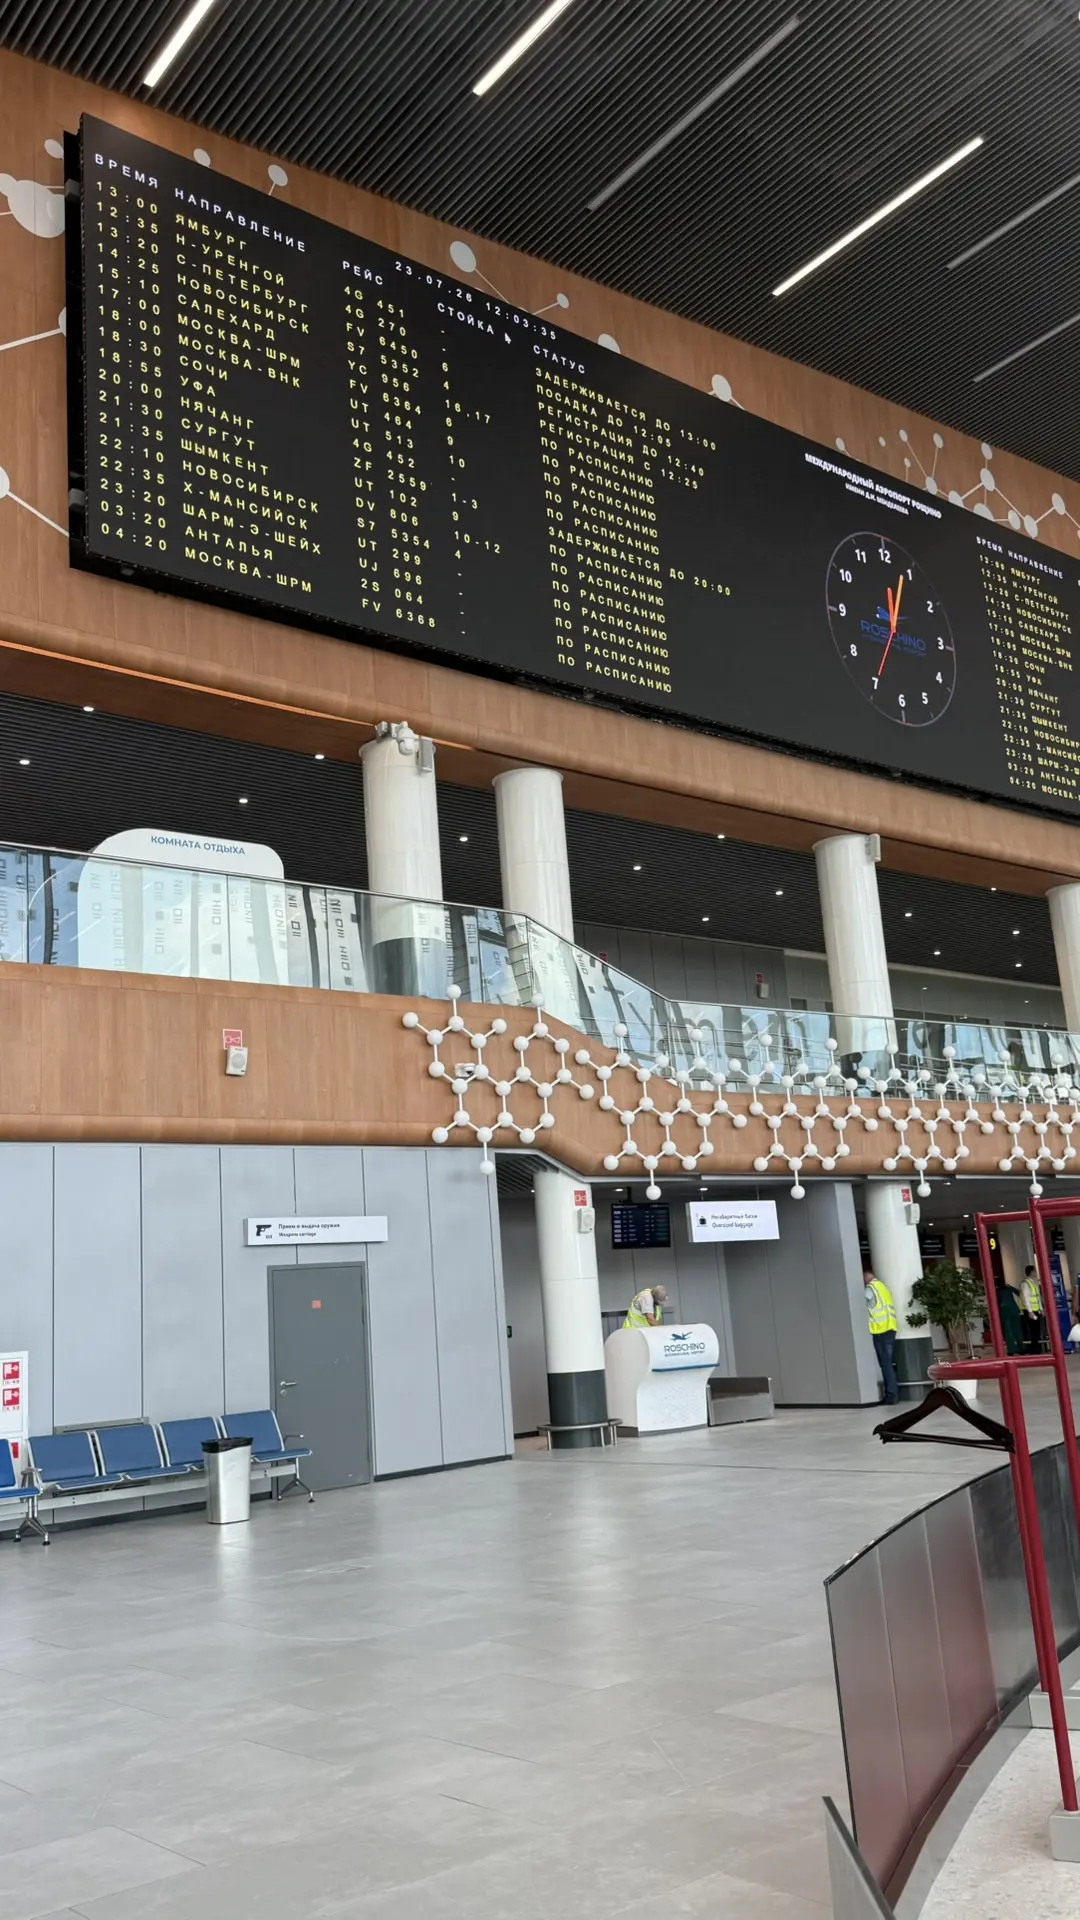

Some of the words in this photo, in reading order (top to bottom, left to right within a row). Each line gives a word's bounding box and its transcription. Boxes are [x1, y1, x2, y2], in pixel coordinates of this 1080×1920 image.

[95, 153, 158, 189] ВРЕМЯ
[175, 188, 305, 252] НАПРАВЛЕНИЕ
[342, 261, 383, 285] РЕЙС
[437, 302, 494, 335] СТОЙКА
[533, 345, 585, 374] СТАТУС
[97, 181, 157, 214] 13:00
[176, 214, 246, 250] ЯМБУРГ
[344, 286, 363, 300] 4G
[377, 300, 404, 318] 451
[536, 367, 646, 421] ЗАДЕРЖИВАЕТСЯ
[656, 418, 670, 431] ДО
[680, 429, 716, 450] 13:00
[395, 261, 472, 302] 23.07.26
[486, 302, 556, 340] 12:03:35
[97, 201, 158, 234] 12:35
[176, 233, 284, 286] Н-УРЕНГОЙ
[345, 305, 364, 318] 4G
[378, 317, 406, 336] 270
[536, 384, 597, 417] ПОСАДКА
[607, 414, 623, 427] ДО
[634, 425, 671, 447] 12:05
[97, 222, 158, 254] 13:20
[177, 254, 308, 313] С-ПЕТЕРБУРГ
[346, 322, 364, 337] FV
[379, 336, 417, 359] 6450
[442, 362, 448, 372] 6
[538, 402, 632, 447] РЕГИСТРАЦИЯ
[642, 445, 657, 457] ДО
[668, 455, 704, 476] 12:40
[98, 243, 159, 274] 14:25
[177, 273, 309, 334] НОВОСИБИРСК
[347, 341, 365, 355] S7
[381, 355, 419, 378] 5352
[443, 381, 449, 390] 4
[540, 419, 634, 464] РЕГИСТРАЦИЯ
[644, 461, 650, 470] С
[661, 469, 698, 489] 12:25
[98, 263, 159, 294] 15:10
[178, 294, 275, 341] САЛЕХАРД
[348, 360, 367, 375] YC
[381, 373, 410, 392] 956
[541, 437, 557, 450] ПО
[568, 447, 653, 488] РАСПИСАНИЮ
[98, 284, 160, 315] 17:00
[178, 313, 300, 368] МОСКВА-ШРМ
[349, 379, 368, 394] FV
[383, 392, 421, 415] 6364
[446, 417, 452, 427] 6
[542, 454, 559, 468] ПО
[570, 465, 655, 504] РАСПИСАНИЮ
[99, 305, 160, 336] 18:00
[178, 334, 300, 388] МОСКВА-ВНК
[350, 398, 369, 413] UT
[384, 412, 412, 429] 464
[447, 436, 454, 445] 9
[544, 472, 560, 486] ПО
[571, 482, 656, 521] РАСПИСАНИЮ
[99, 326, 161, 356] 18:30
[180, 355, 227, 381] СОЧИ
[351, 418, 370, 432] UT
[385, 430, 413, 449] 513
[449, 455, 465, 468] 10
[545, 490, 562, 503] ПО
[573, 500, 658, 538] РАСПИСАНИЮ
[99, 348, 161, 377] 18:55
[180, 375, 216, 397] УФА
[353, 438, 372, 452] 4G
[386, 450, 414, 468] 452
[547, 508, 563, 521] ПО
[574, 518, 659, 555] РАСПИСАНИЮ
[99, 368, 162, 399] 20:00
[181, 396, 254, 429] НЯЧАНГ
[354, 457, 372, 471] ZF
[388, 469, 426, 491] 2559
[452, 493, 478, 509] 1-3
[549, 526, 660, 572] ЗАДЕРЖИВАЕТСЯ
[670, 568, 684, 580] ДО
[694, 576, 730, 596] 20:00
[99, 390, 163, 420] 21:30
[181, 418, 255, 451] СУРГУТ
[355, 477, 373, 491] UT
[389, 490, 417, 507] 102
[452, 511, 459, 521] 9
[550, 544, 566, 557] ПО
[577, 553, 662, 589] РАСПИСАНИЮ
[100, 434, 164, 463] 22:10
[183, 460, 318, 513] НОВОСИБИРСК
[357, 517, 375, 531] S7
[391, 528, 430, 549] 5354
[455, 550, 461, 559] 4
[805, 452, 874, 490] МЕЖДУНАРОДНЫЙ
[875, 484, 911, 506] АЭРОПОРТ
[911, 500, 942, 519] РОЩИНО
[99, 412, 163, 441] 21:35
[181, 438, 268, 475] ШЫМКЕНТ
[356, 497, 375, 511] DV
[390, 509, 418, 526] 806
[454, 531, 500, 554] 10-12
[551, 562, 567, 575] ПО
[579, 571, 664, 606] РАСПИСАНИЮ
[100, 456, 164, 484] 22:35
[184, 481, 307, 530] Х-МАНСИЙСК
[358, 537, 377, 551] UT
[392, 548, 421, 565] 299
[101, 478, 165, 506] 23:20
[183, 503, 320, 554] ШАРМ-Э-ШЕЙХ
[359, 557, 377, 571] UJ
[393, 568, 422, 585] 696
[101, 500, 166, 528] 03:20
[185, 526, 272, 560] АНТАЛЬЯ
[361, 578, 380, 592] 2S
[395, 588, 423, 604] 064
[854, 548, 867, 564] 11
[878, 548, 892, 564] 12
[101, 523, 167, 551] 04:20
[185, 547, 311, 592] МОСКВА-ШРМ
[362, 598, 381, 612] FV
[396, 608, 435, 627] 6368
[838, 603, 847, 617] 9
[839, 568, 853, 583] 10
[906, 568, 913, 581] 1
[926, 600, 934, 613] 2
[850, 643, 858, 657] 8
[871, 676, 879, 690] 7
[935, 671, 943, 684] 4
[937, 637, 945, 650] 3
[898, 694, 906, 708] 6
[921, 692, 929, 705] 5
[151, 835, 201, 849] КОМНАТА
[203, 842, 246, 855] ОТДЫХА
[990, 1237, 996, 1250] 9
[664, 1342, 706, 1353] ROSCHINO
